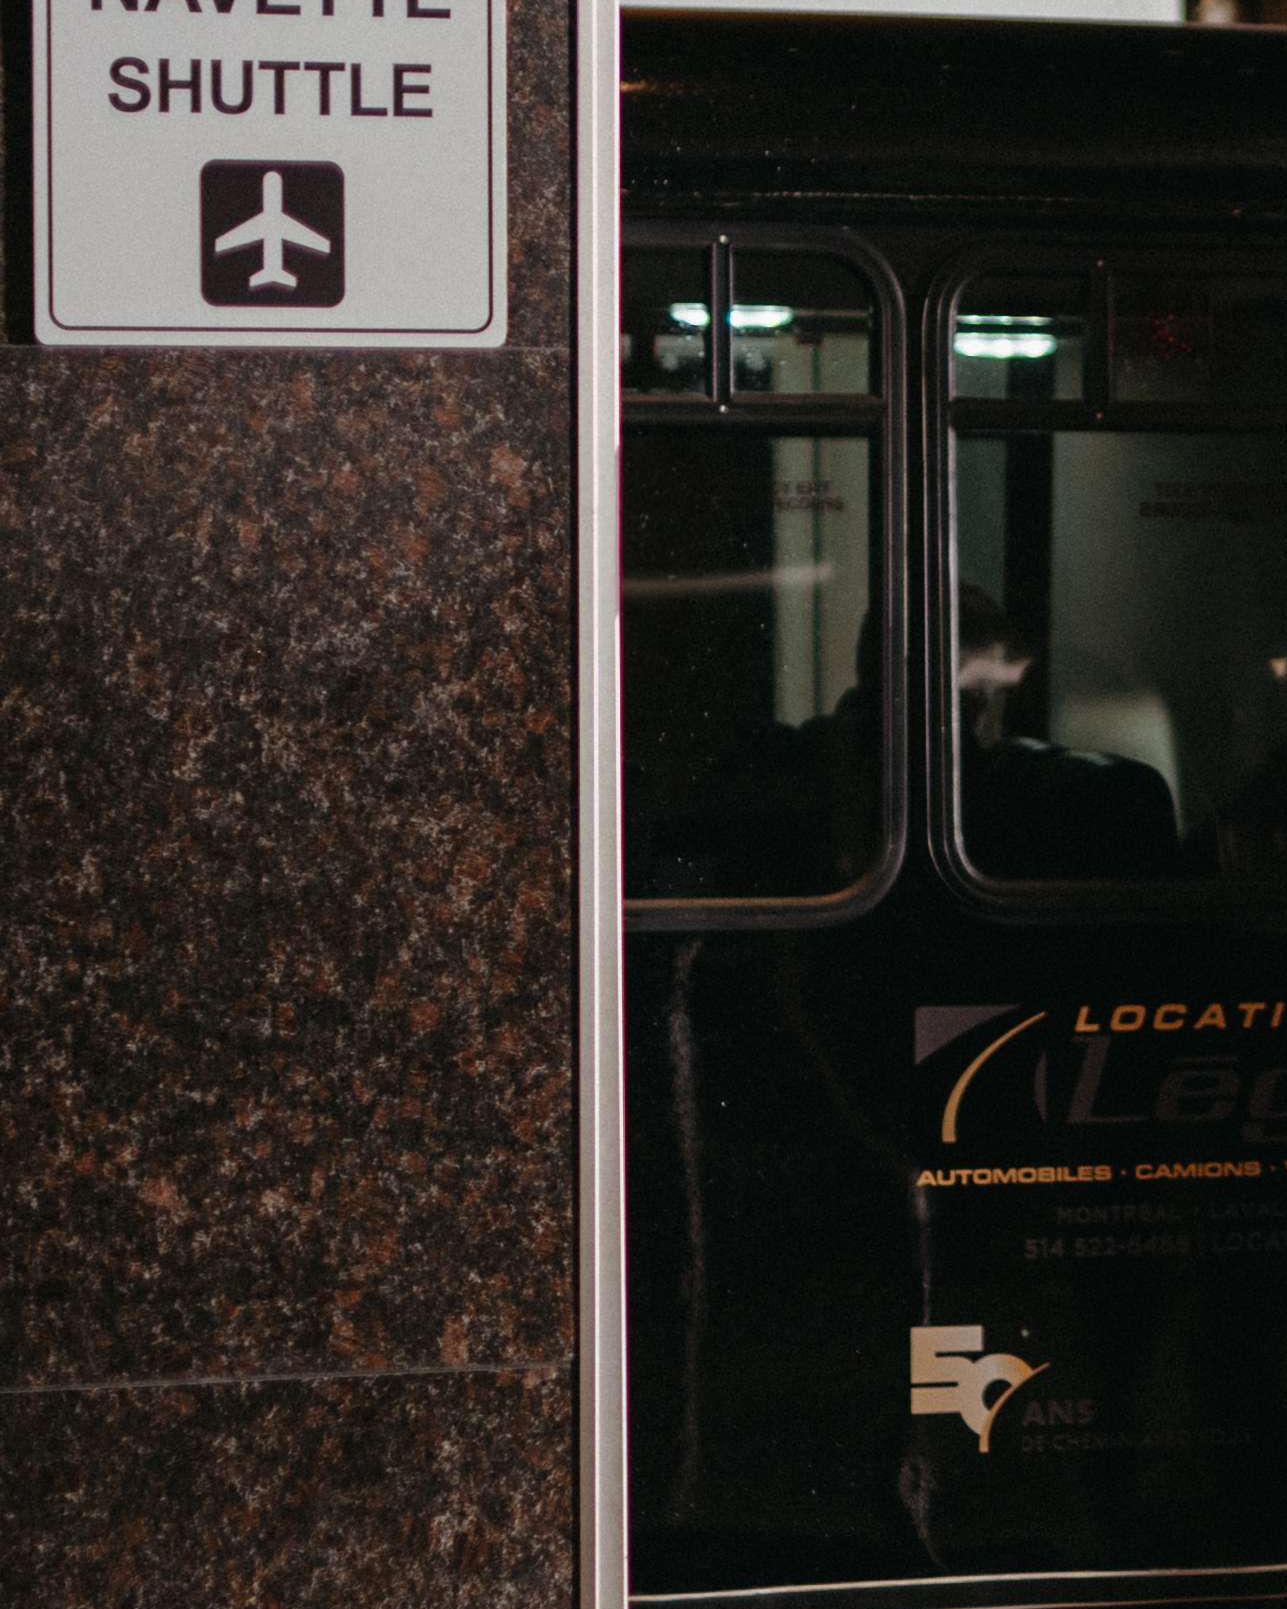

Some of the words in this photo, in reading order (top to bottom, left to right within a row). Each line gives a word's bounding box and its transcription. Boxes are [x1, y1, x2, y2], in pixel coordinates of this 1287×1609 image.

[108, 56, 432, 118] SHUTTLE
[916, 1164, 1112, 1188] AUTOMOBILES
[1135, 1160, 1261, 1181] CAMIONS
[1025, 1238, 1064, 1260] 514
[1021, 1399, 1095, 1427] ANS
